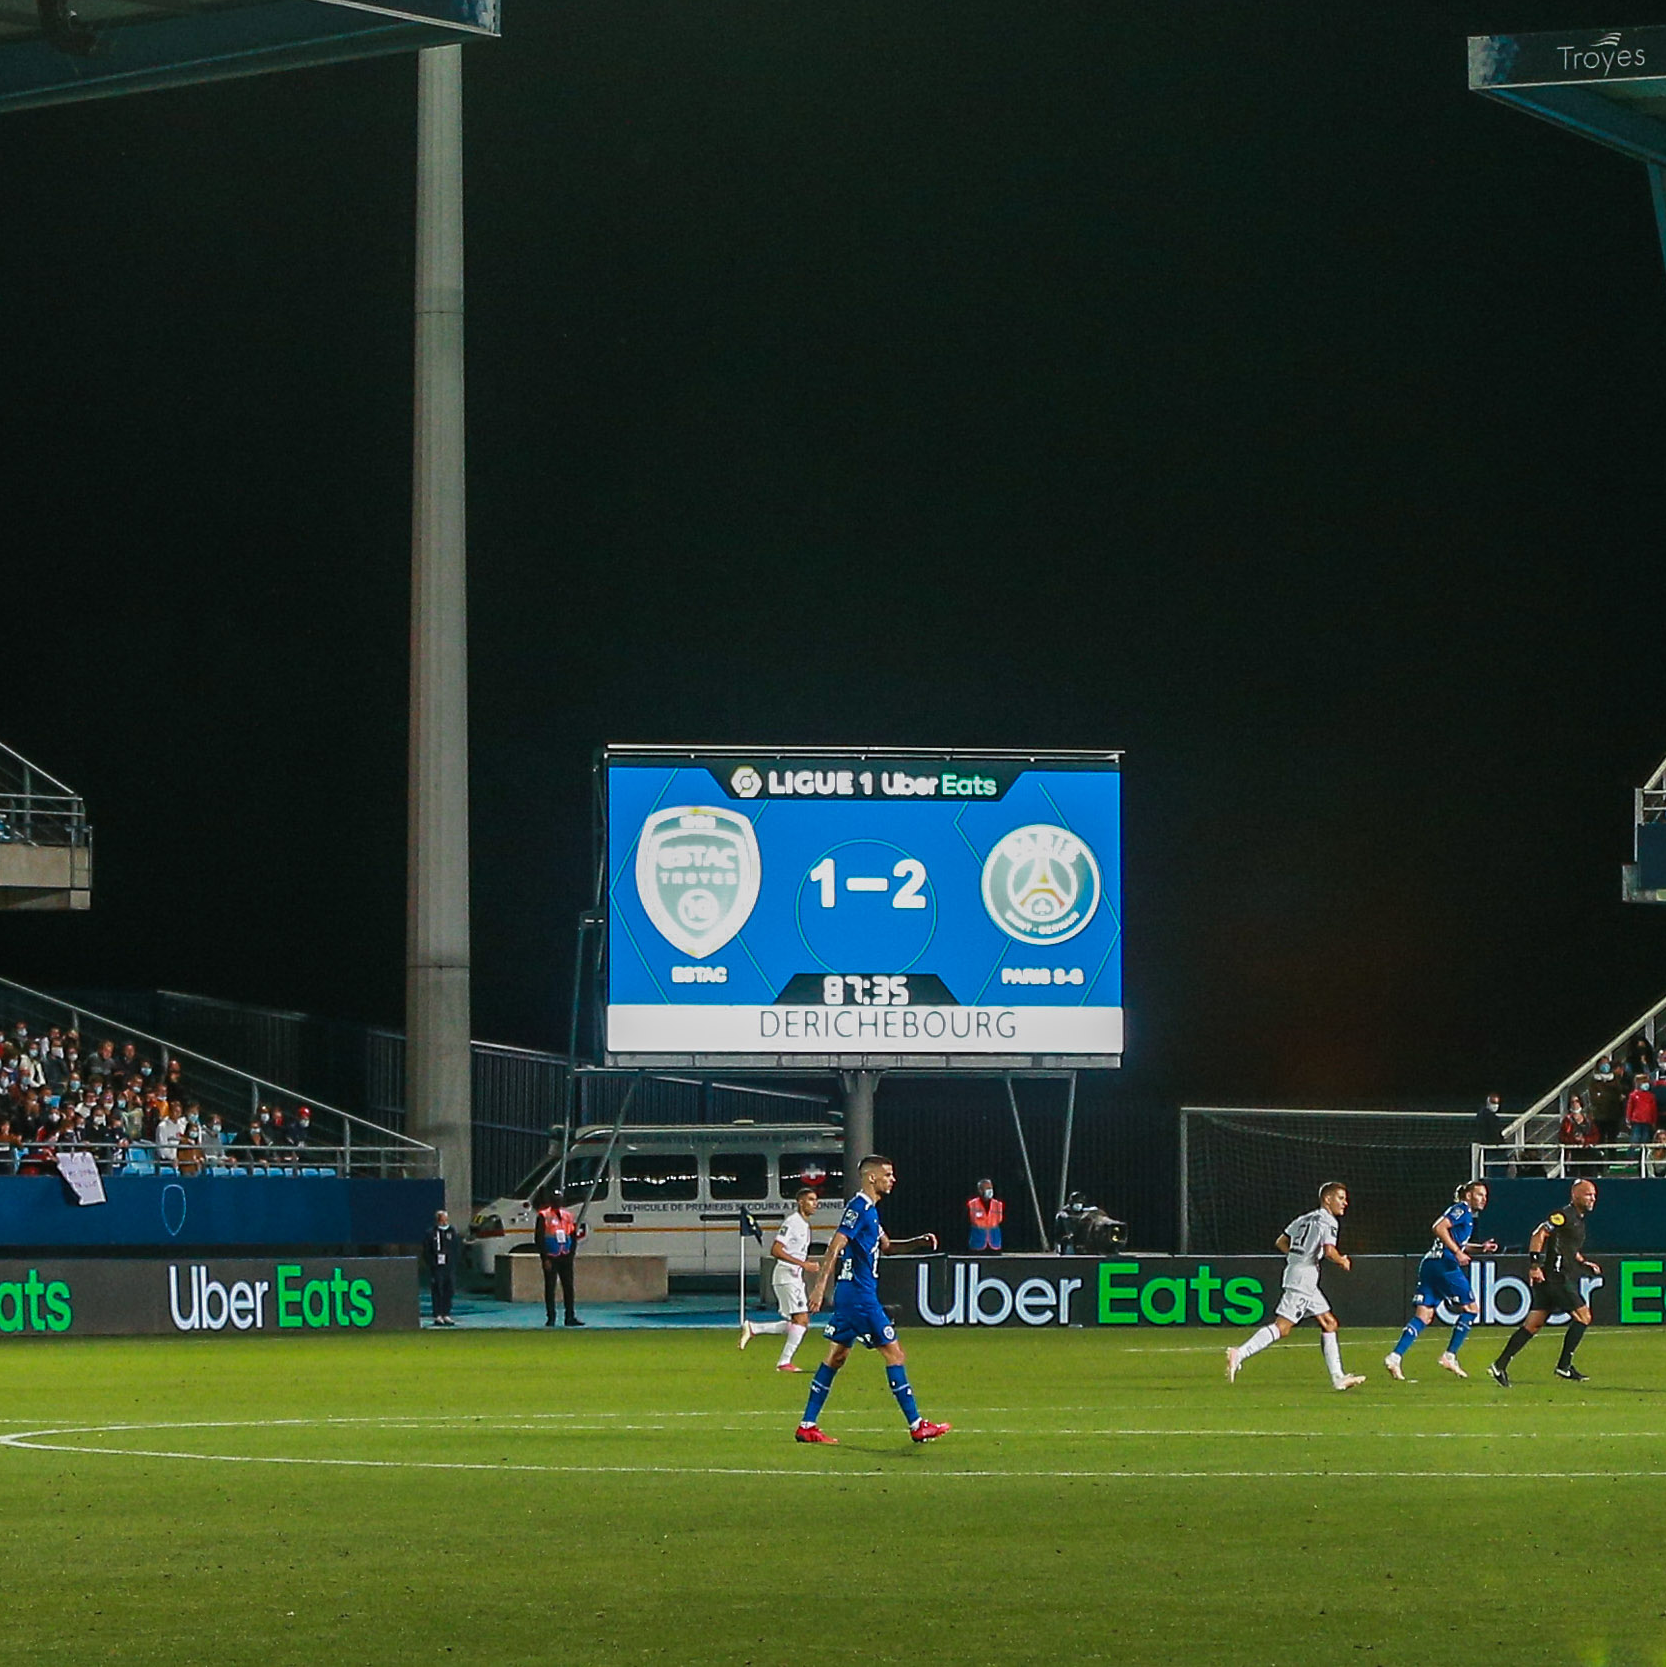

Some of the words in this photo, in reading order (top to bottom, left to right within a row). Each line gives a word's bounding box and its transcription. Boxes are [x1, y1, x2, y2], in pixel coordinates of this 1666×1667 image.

[1557, 44, 1646, 76] Troyes
[768, 770, 854, 795] LIGUE
[859, 772, 873, 795] 1
[882, 772, 939, 795] Uber
[942, 774, 997, 795] Eats
[823, 975, 909, 1005] 87:35
[760, 1010, 1016, 1038] DERICHEBOURG
[622, 1204, 669, 1212] VEHICULE
[670, 1204, 683, 1212] DE
[686, 1203, 731, 1212] PREMIERS
[782, 1202, 790, 1210] A
[168, 1264, 268, 1331] Uber
[277, 1264, 374, 1328] Eats
[916, 1262, 1082, 1325] Uber
[1098, 1262, 1264, 1324] Eats
